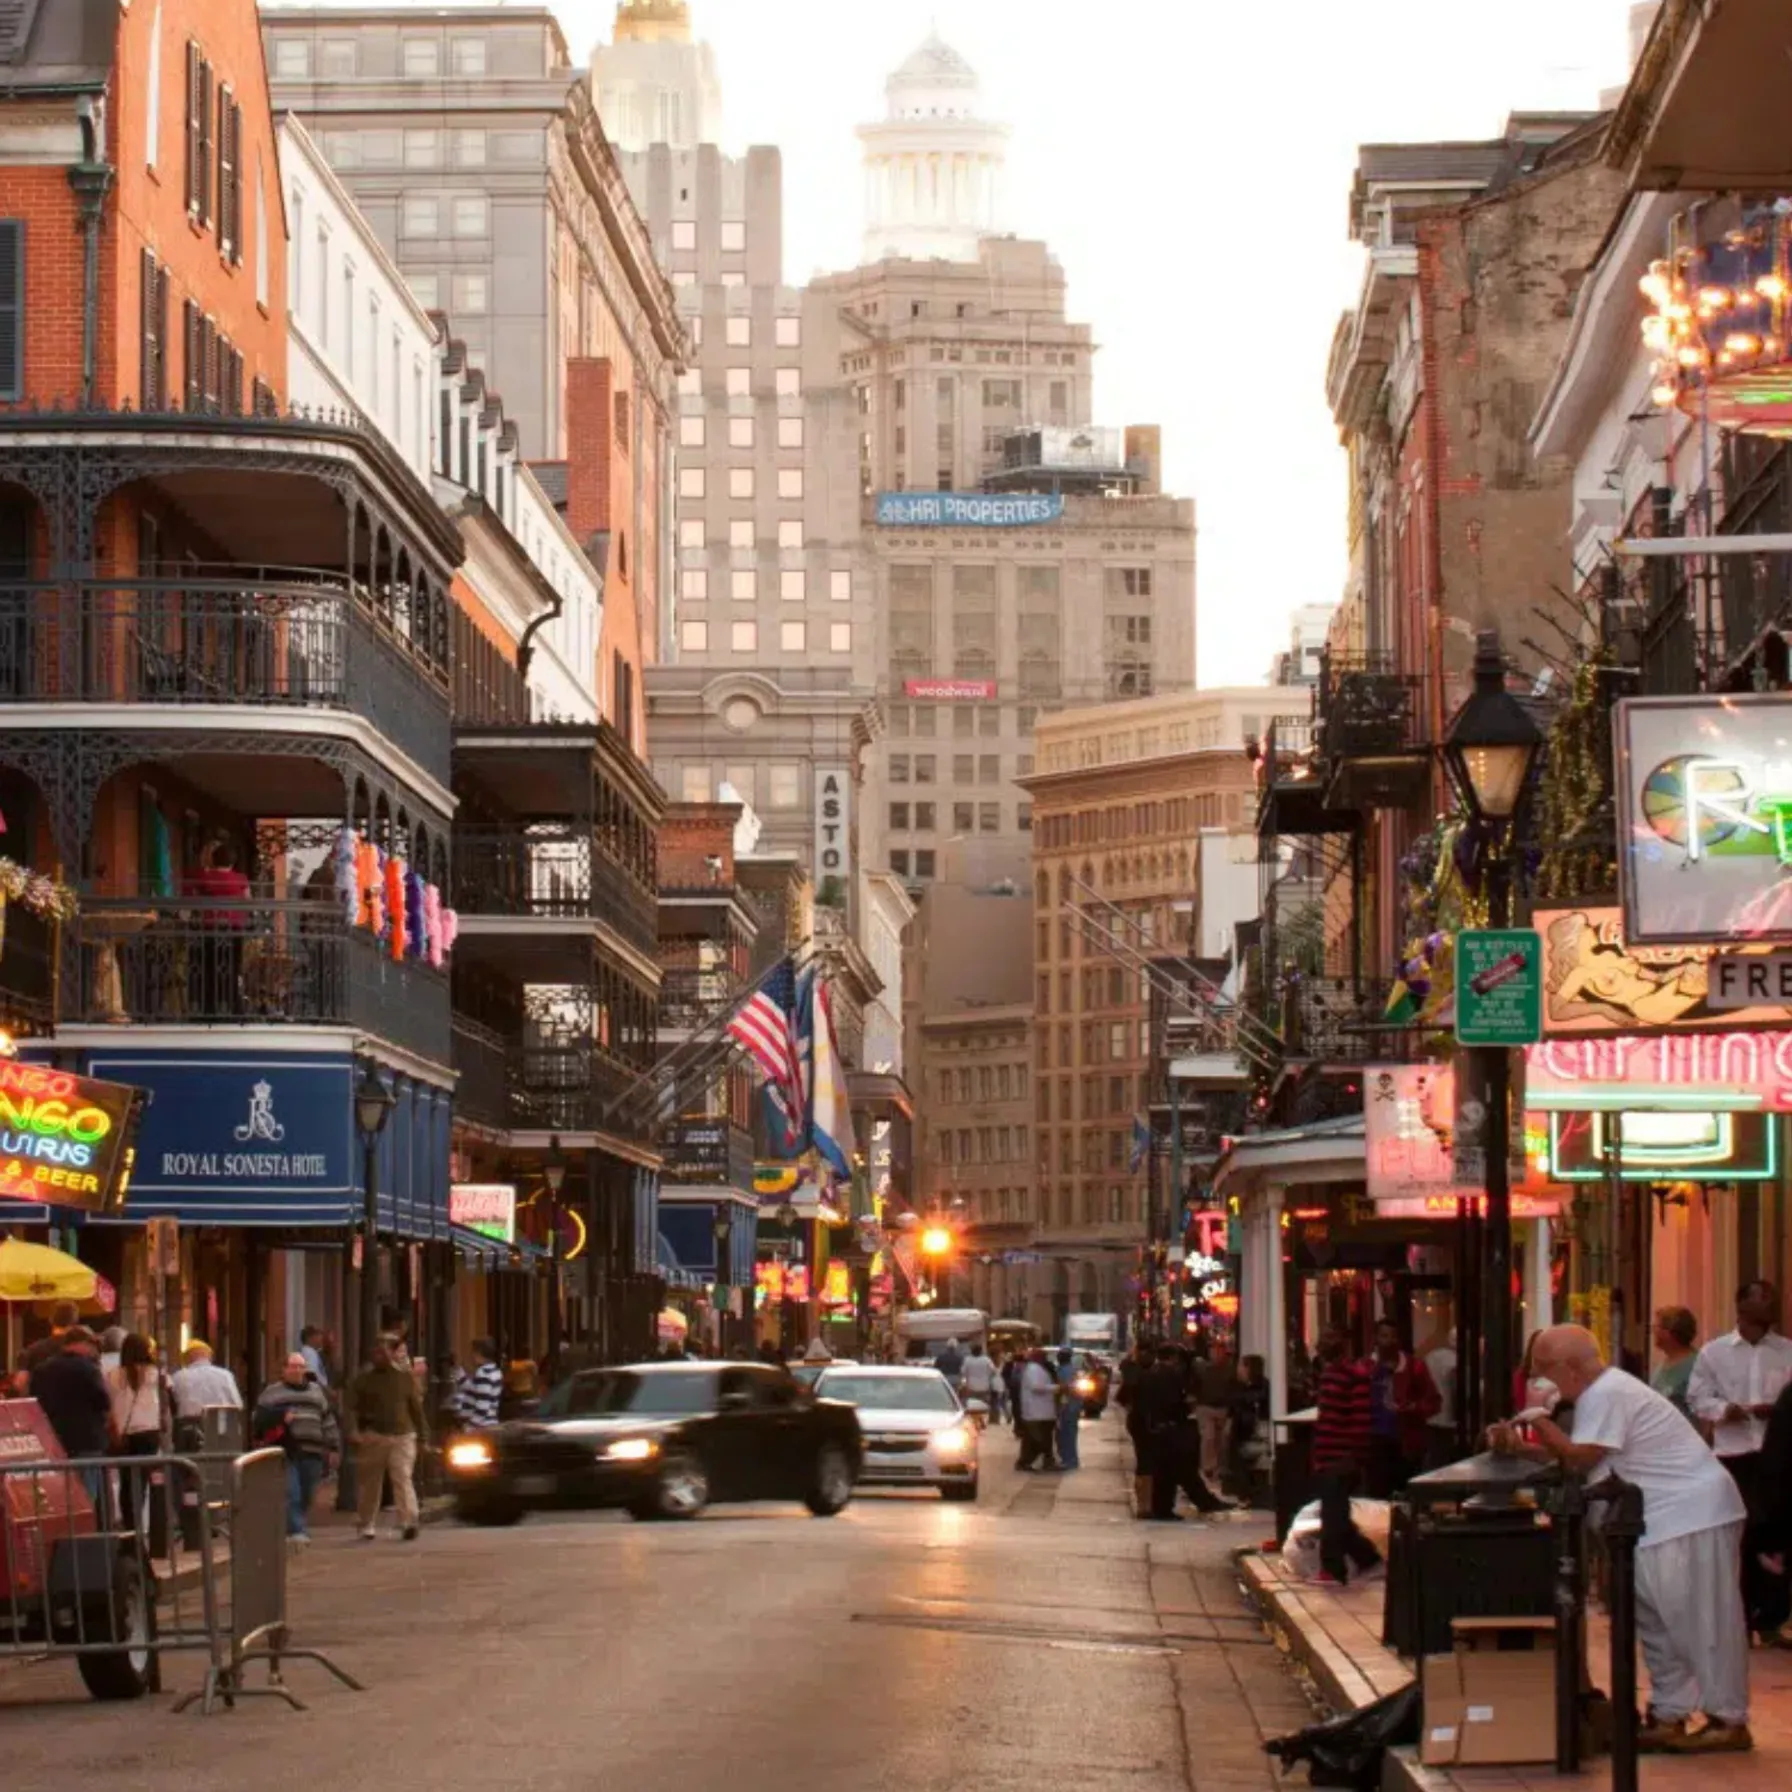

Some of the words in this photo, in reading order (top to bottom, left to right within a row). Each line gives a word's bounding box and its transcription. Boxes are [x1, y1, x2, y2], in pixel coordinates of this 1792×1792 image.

[909, 498, 941, 521] HRI
[945, 498, 1051, 523] PROPERTIES
[162, 1152, 221, 1176] ROYAL
[223, 1153, 290, 1177] SONESTA
[292, 1154, 328, 1177] HOTEL
[33, 1165, 98, 1193] BEER
